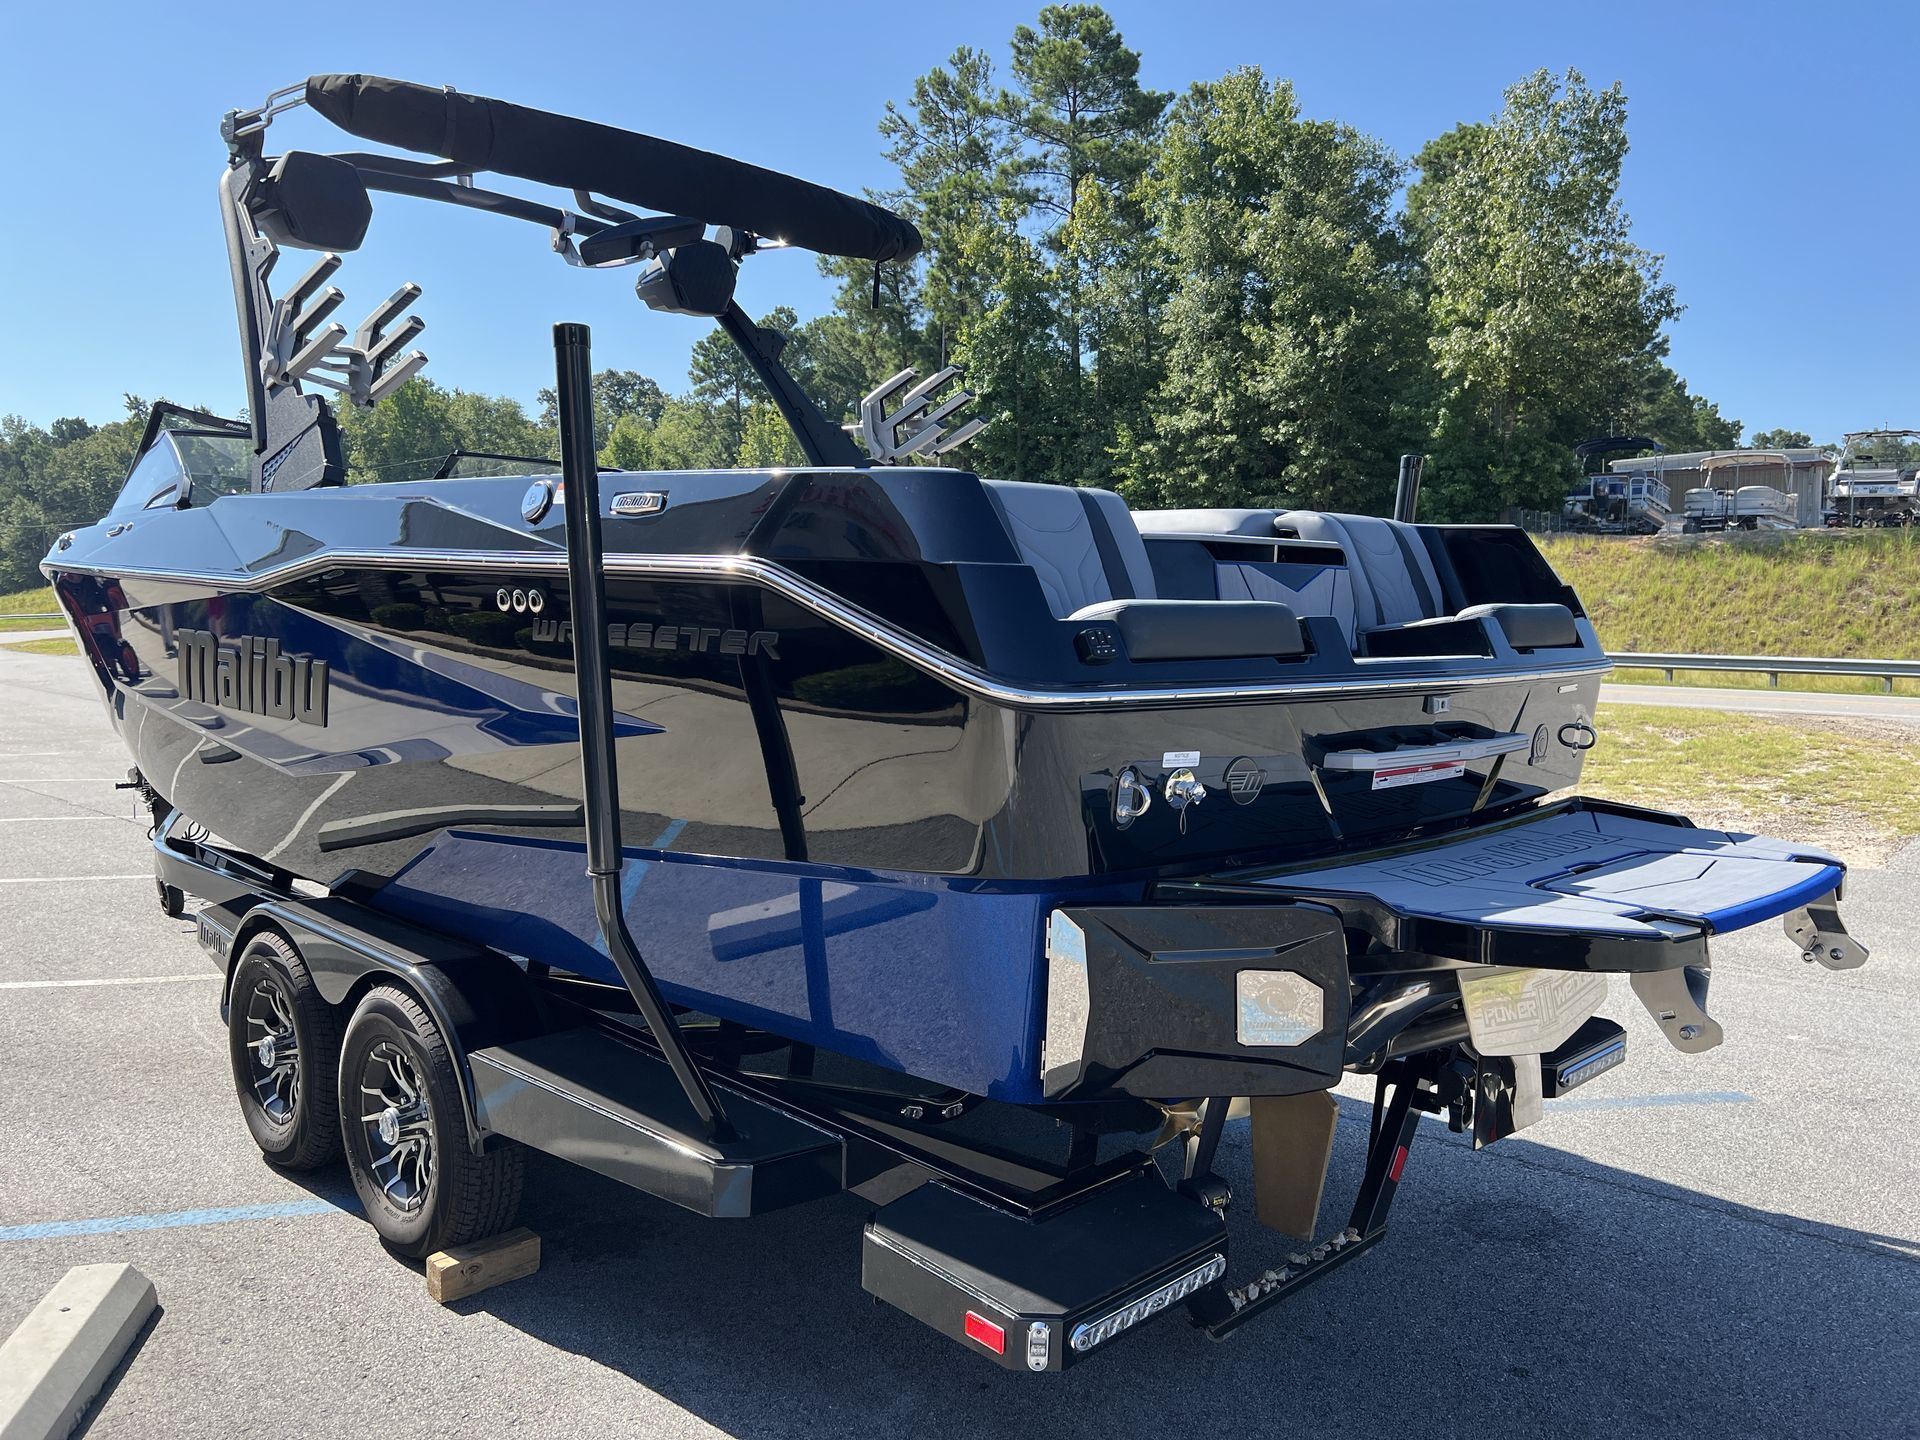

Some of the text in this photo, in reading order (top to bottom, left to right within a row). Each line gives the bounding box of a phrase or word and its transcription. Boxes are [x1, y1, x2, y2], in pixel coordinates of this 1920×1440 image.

[225, 422, 248, 431] Malibu
[615, 496, 653, 508] Malibu
[533, 617, 780, 660] WAESETTER
[178, 628, 329, 728] Malibu
[1379, 829, 1625, 887] Malibu
[200, 921, 228, 957] Malibu
[1484, 1000, 1537, 1027] POWER
